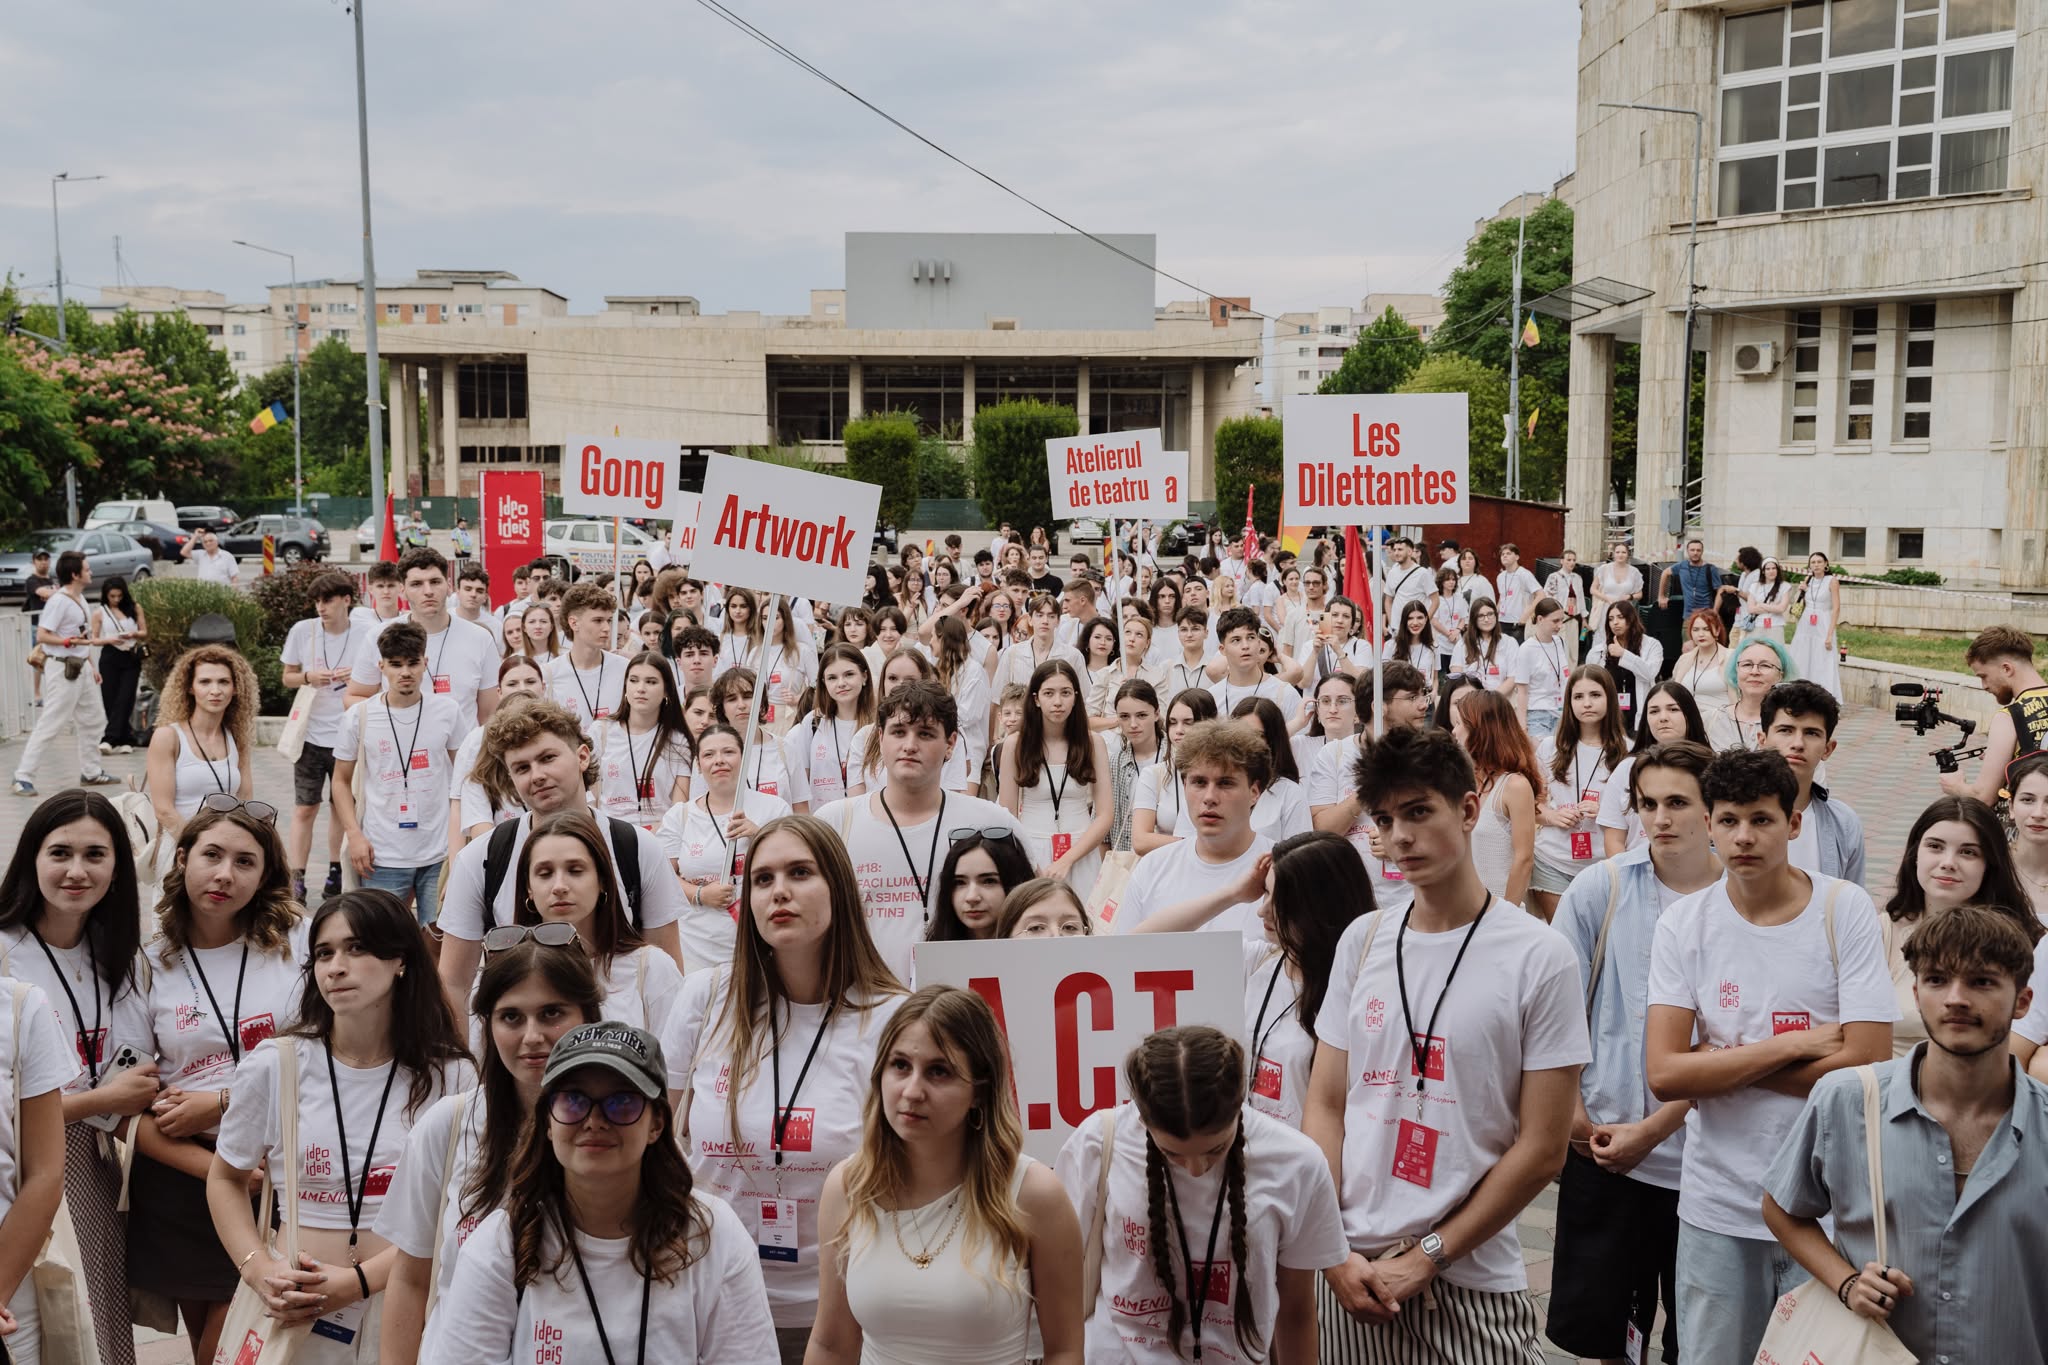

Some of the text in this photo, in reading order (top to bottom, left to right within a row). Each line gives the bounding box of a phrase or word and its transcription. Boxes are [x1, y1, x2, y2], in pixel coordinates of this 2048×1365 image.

[1353, 413, 1400, 457] Les
[1066, 440, 1142, 475] Atelierul
[580, 445, 665, 510] Gong
[1298, 462, 1457, 507] Dilettantes
[1069, 477, 1150, 508] de teatru
[498, 494, 529, 519] ideo
[498, 516, 530, 538] ideis
[713, 493, 856, 570] Artwork
[856, 862, 882, 874] #18:
[875, 891, 925, 903] SEMEN
[1719, 979, 1739, 996] ideo
[1366, 995, 1385, 1011] ideo
[1719, 995, 1740, 1008] ideis
[1365, 1012, 1384, 1028] ideis
[719, 1062, 730, 1077] id
[715, 1077, 730, 1094] ide
[306, 1143, 330, 1161] ideo
[306, 1161, 331, 1177] ideis
[1122, 1215, 1145, 1237] ideo
[1113, 1294, 1170, 1312] OAMENII
[534, 1319, 563, 1345] ideo
[536, 1344, 563, 1365] deis
